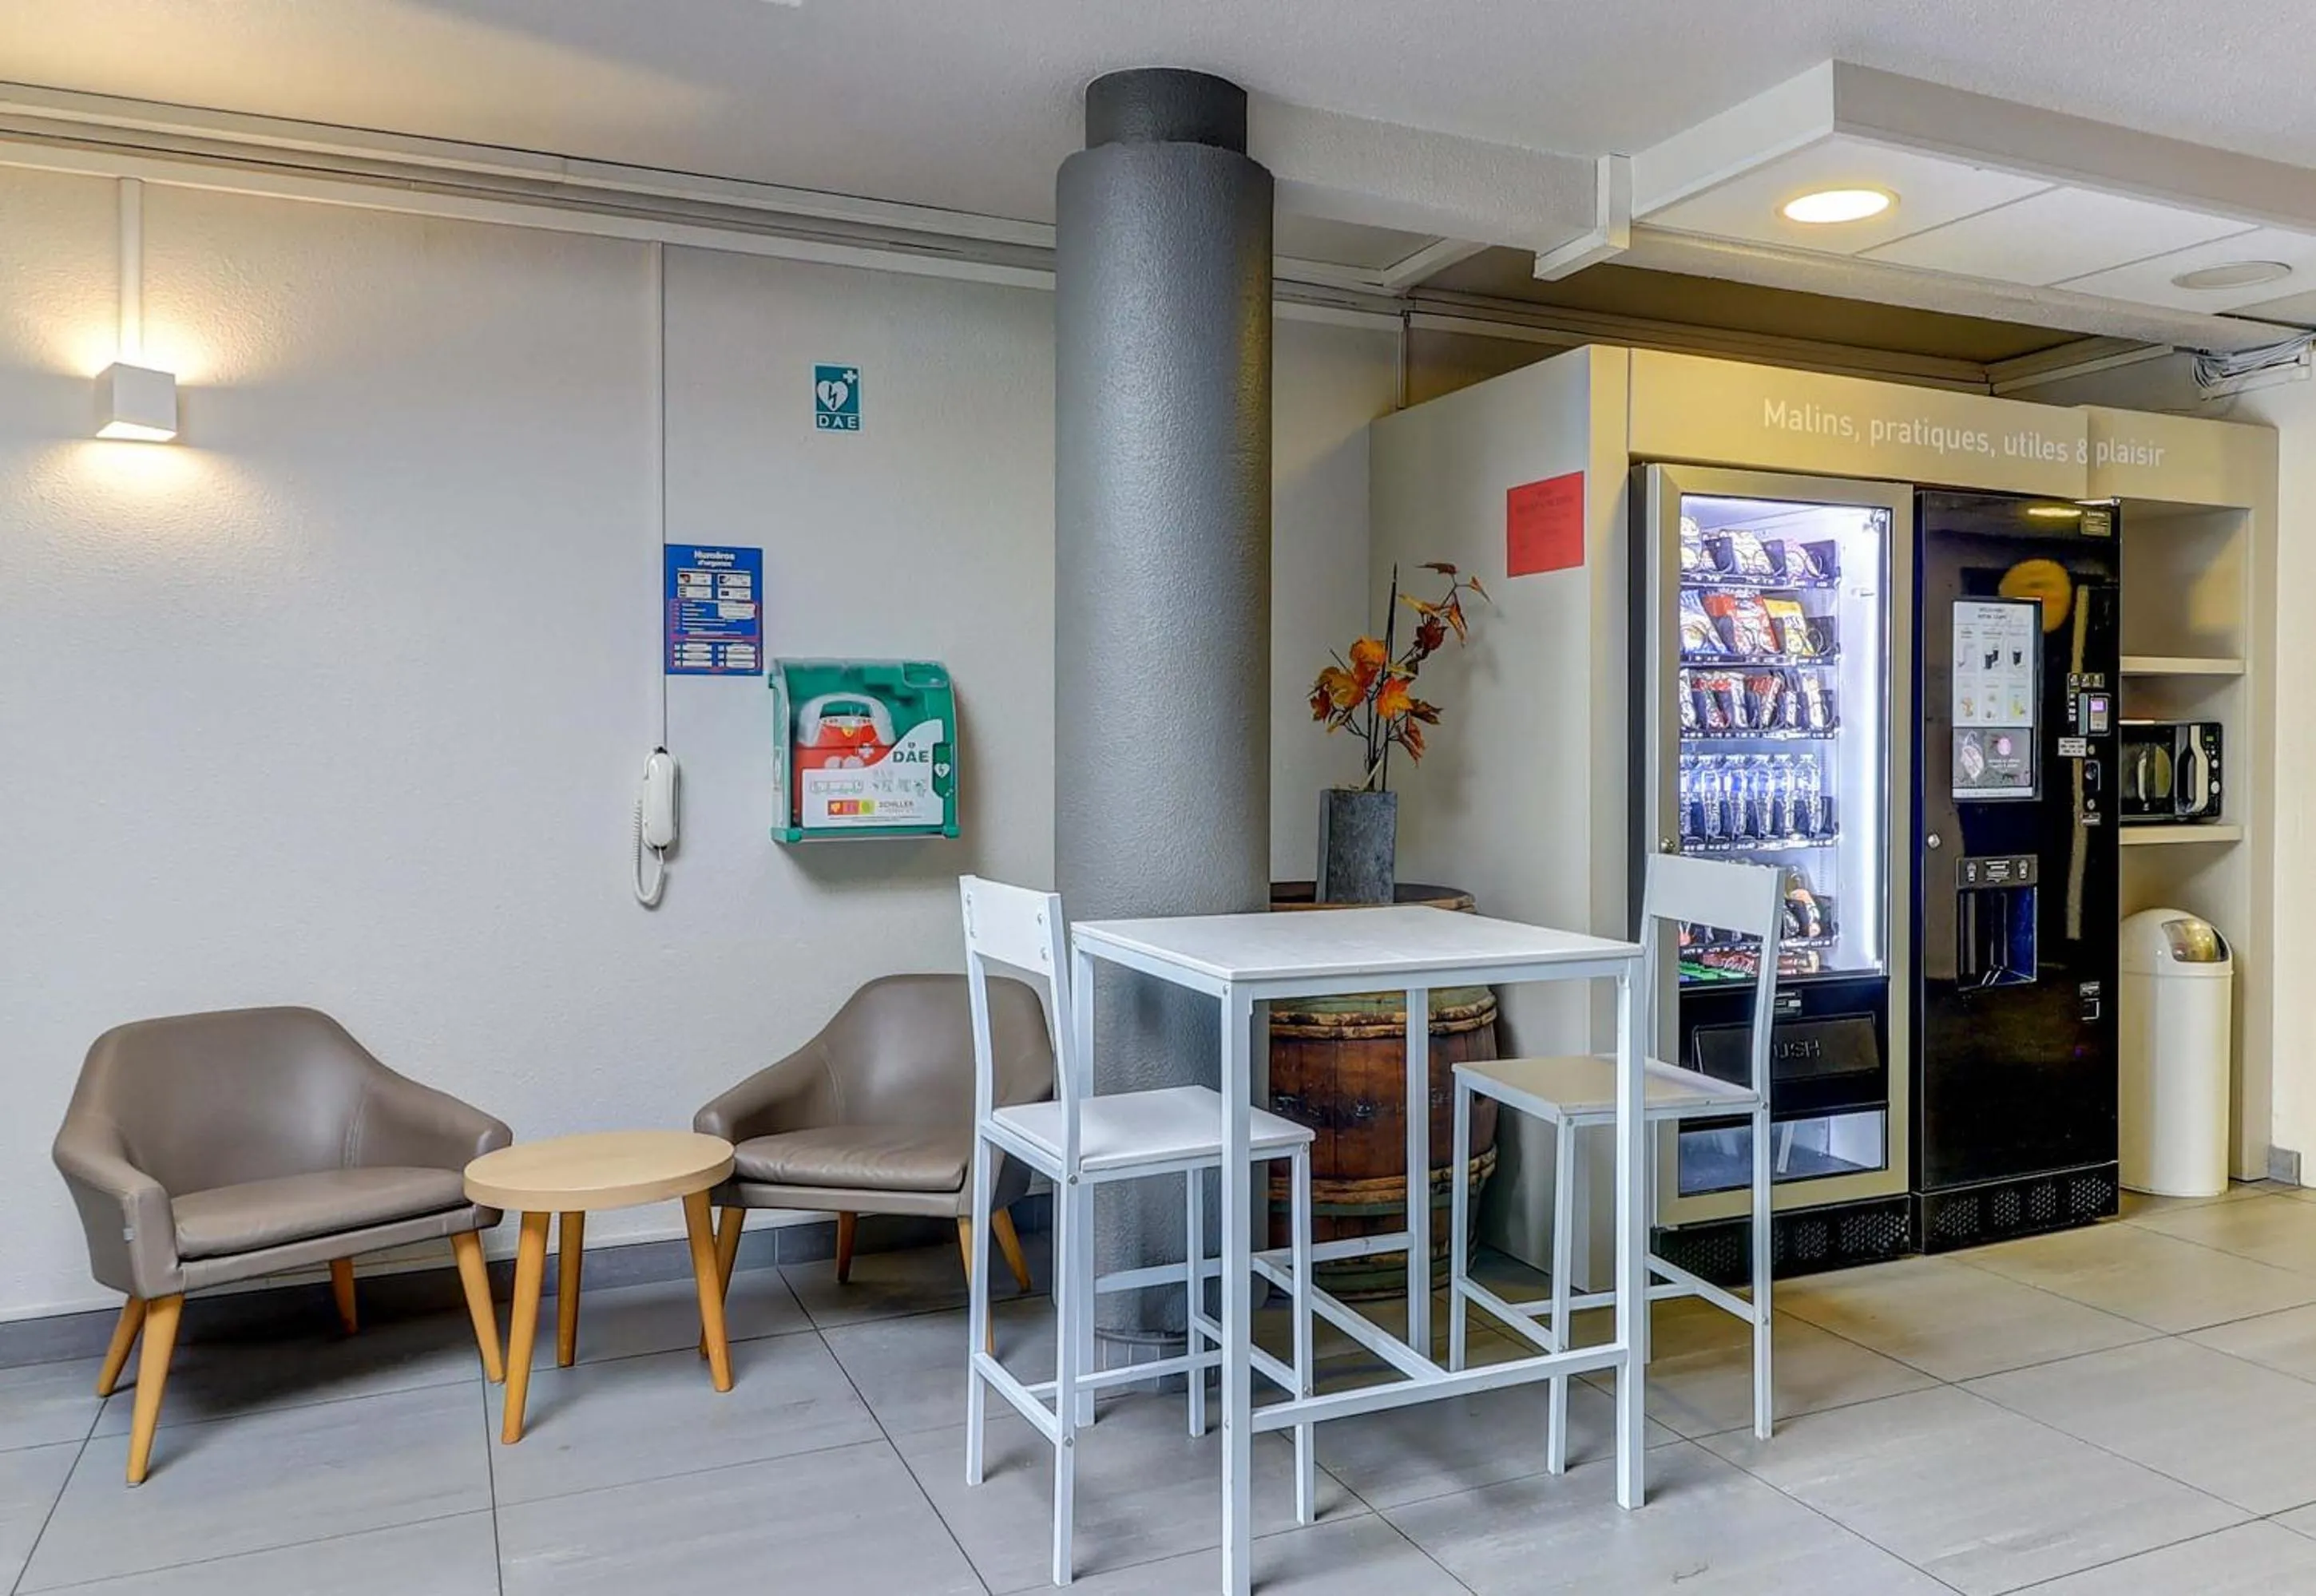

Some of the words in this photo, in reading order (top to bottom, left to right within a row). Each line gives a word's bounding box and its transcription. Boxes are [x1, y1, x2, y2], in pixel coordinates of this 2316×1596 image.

[819, 414, 857, 429] DAE
[1764, 398, 1860, 443] Malins,
[1870, 418, 1996, 458] pratiques,
[2004, 431, 2069, 462] utiles
[2076, 438, 2088, 465] &
[2096, 440, 2166, 468] plaisir
[892, 750, 930, 763] DAE
[1773, 1039, 1821, 1058] USH
